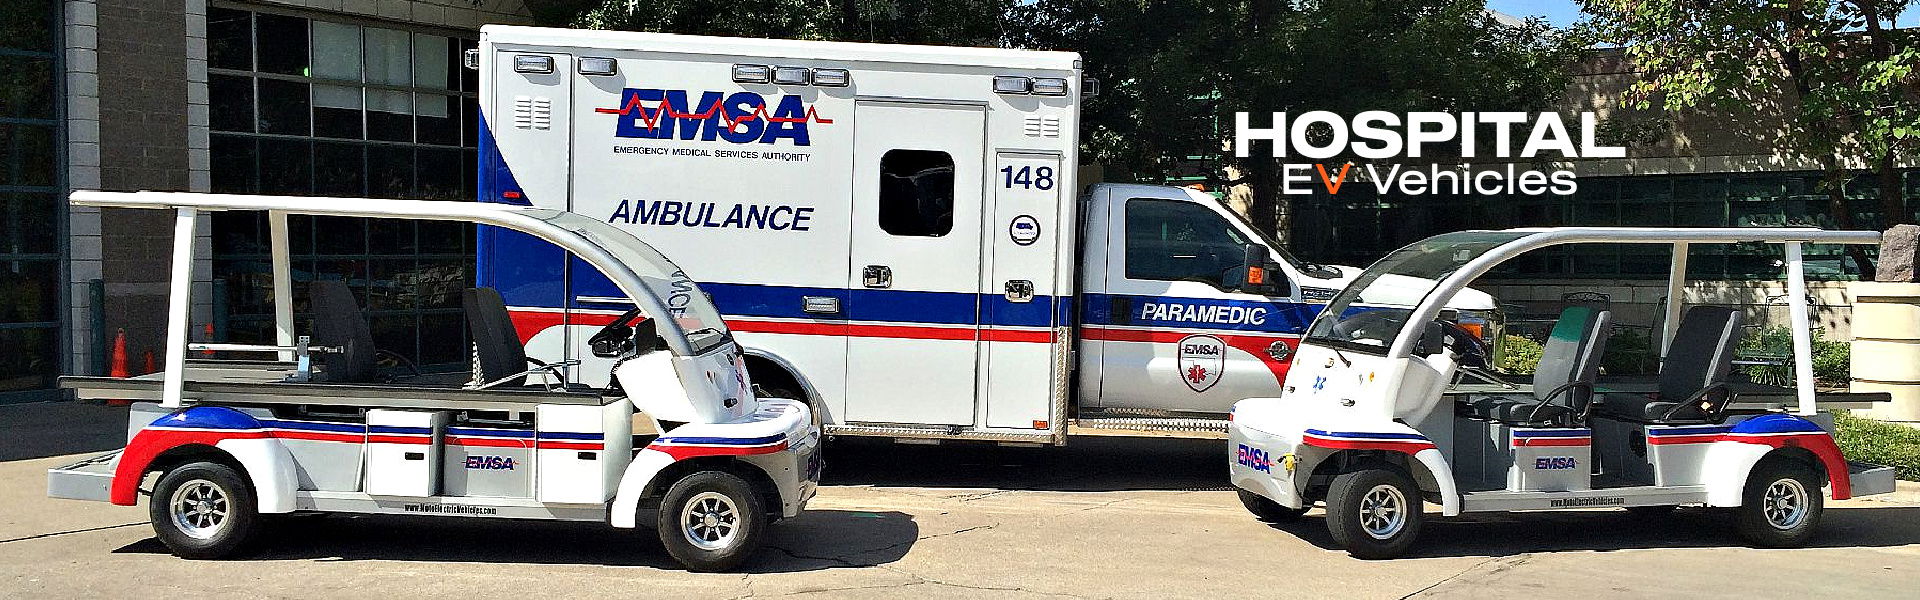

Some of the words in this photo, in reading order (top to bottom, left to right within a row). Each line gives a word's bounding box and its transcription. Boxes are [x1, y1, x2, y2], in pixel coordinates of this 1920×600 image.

[614, 88, 811, 146] EMSA
[613, 146, 669, 156] EMERGENCY
[672, 148, 712, 157] MEDICAL
[714, 150, 758, 159] SERVICES
[761, 152, 811, 162] AUTHORITY
[1001, 165, 1054, 190] 148
[609, 199, 815, 232] AMBULANCE
[1141, 303, 1267, 325] PARAMEDIC
[1184, 344, 1220, 356] EMSA
[465, 455, 515, 470] EMSA
[1238, 443, 1271, 474] EMSA
[1535, 457, 1576, 470] EMSA
